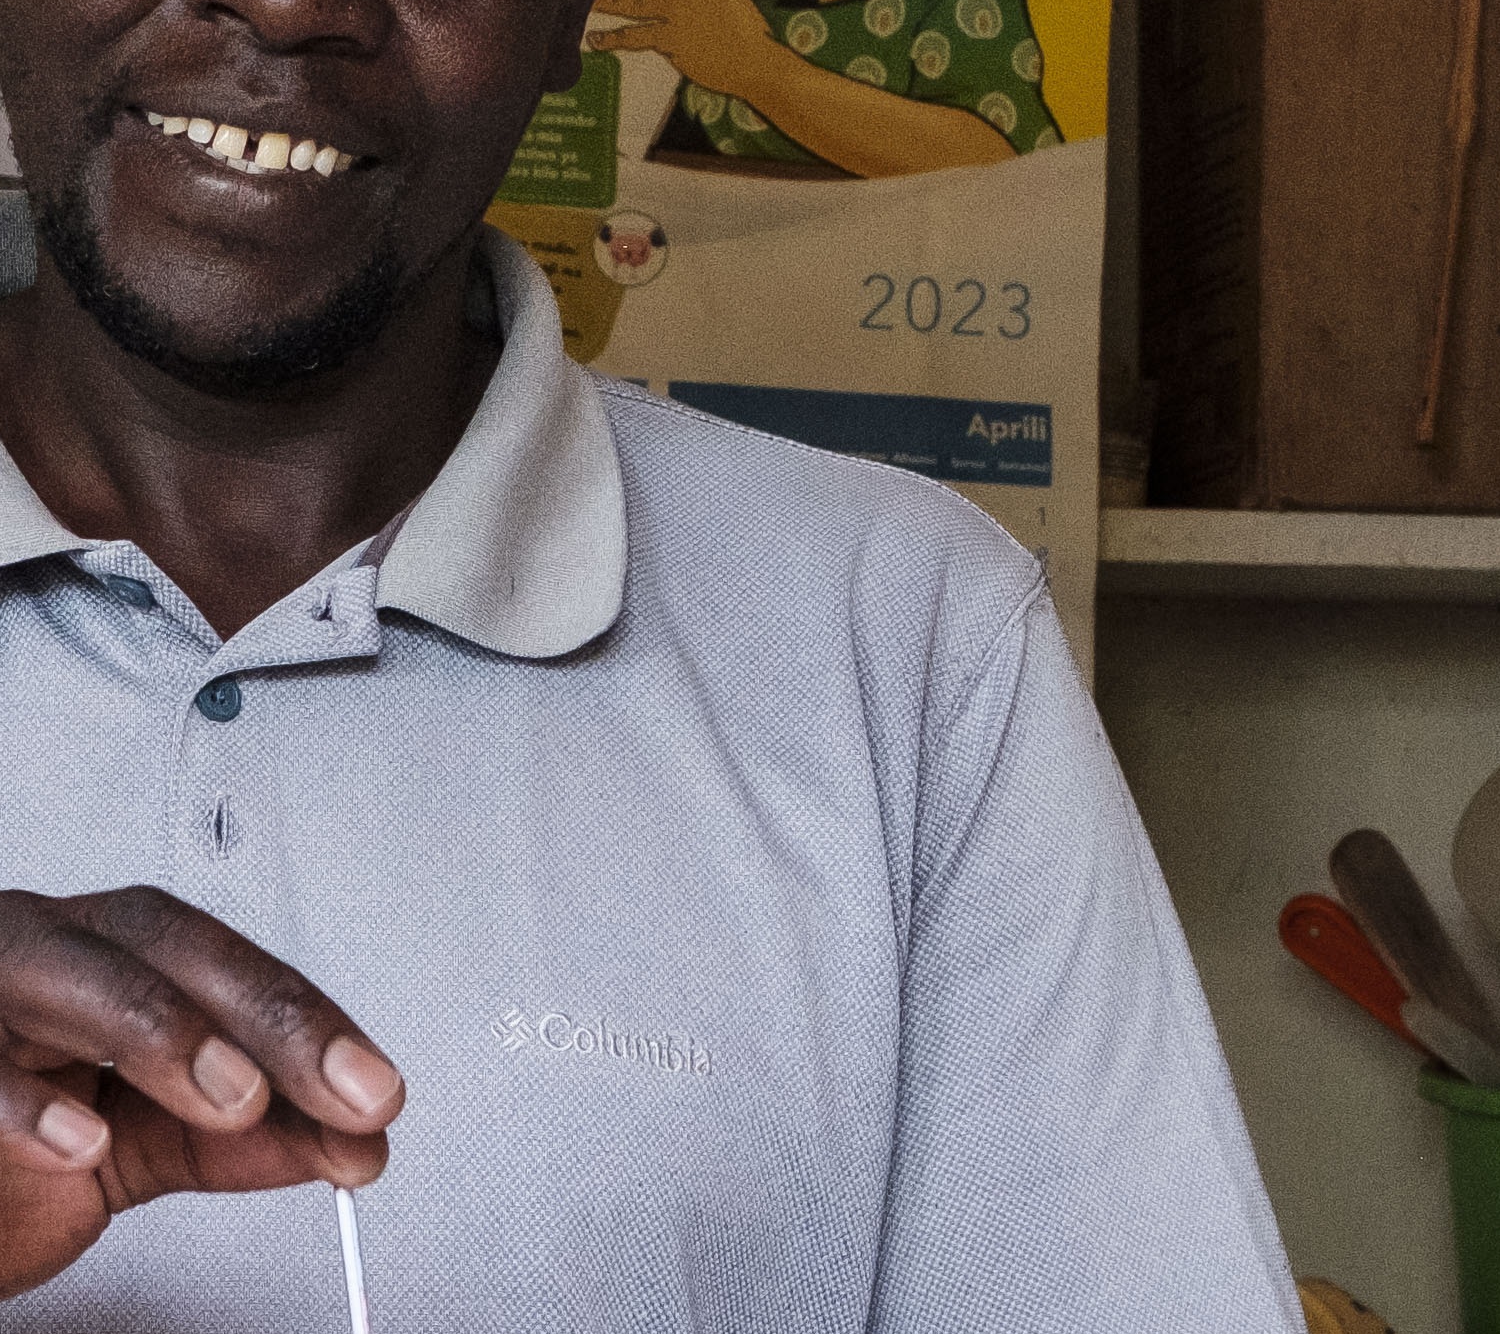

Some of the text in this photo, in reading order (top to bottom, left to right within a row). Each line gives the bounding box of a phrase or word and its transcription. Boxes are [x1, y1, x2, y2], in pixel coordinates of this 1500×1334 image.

[859, 274, 1031, 340] 2023
[967, 414, 1047, 447] Aprili
[539, 1013, 712, 1075] Columbia
